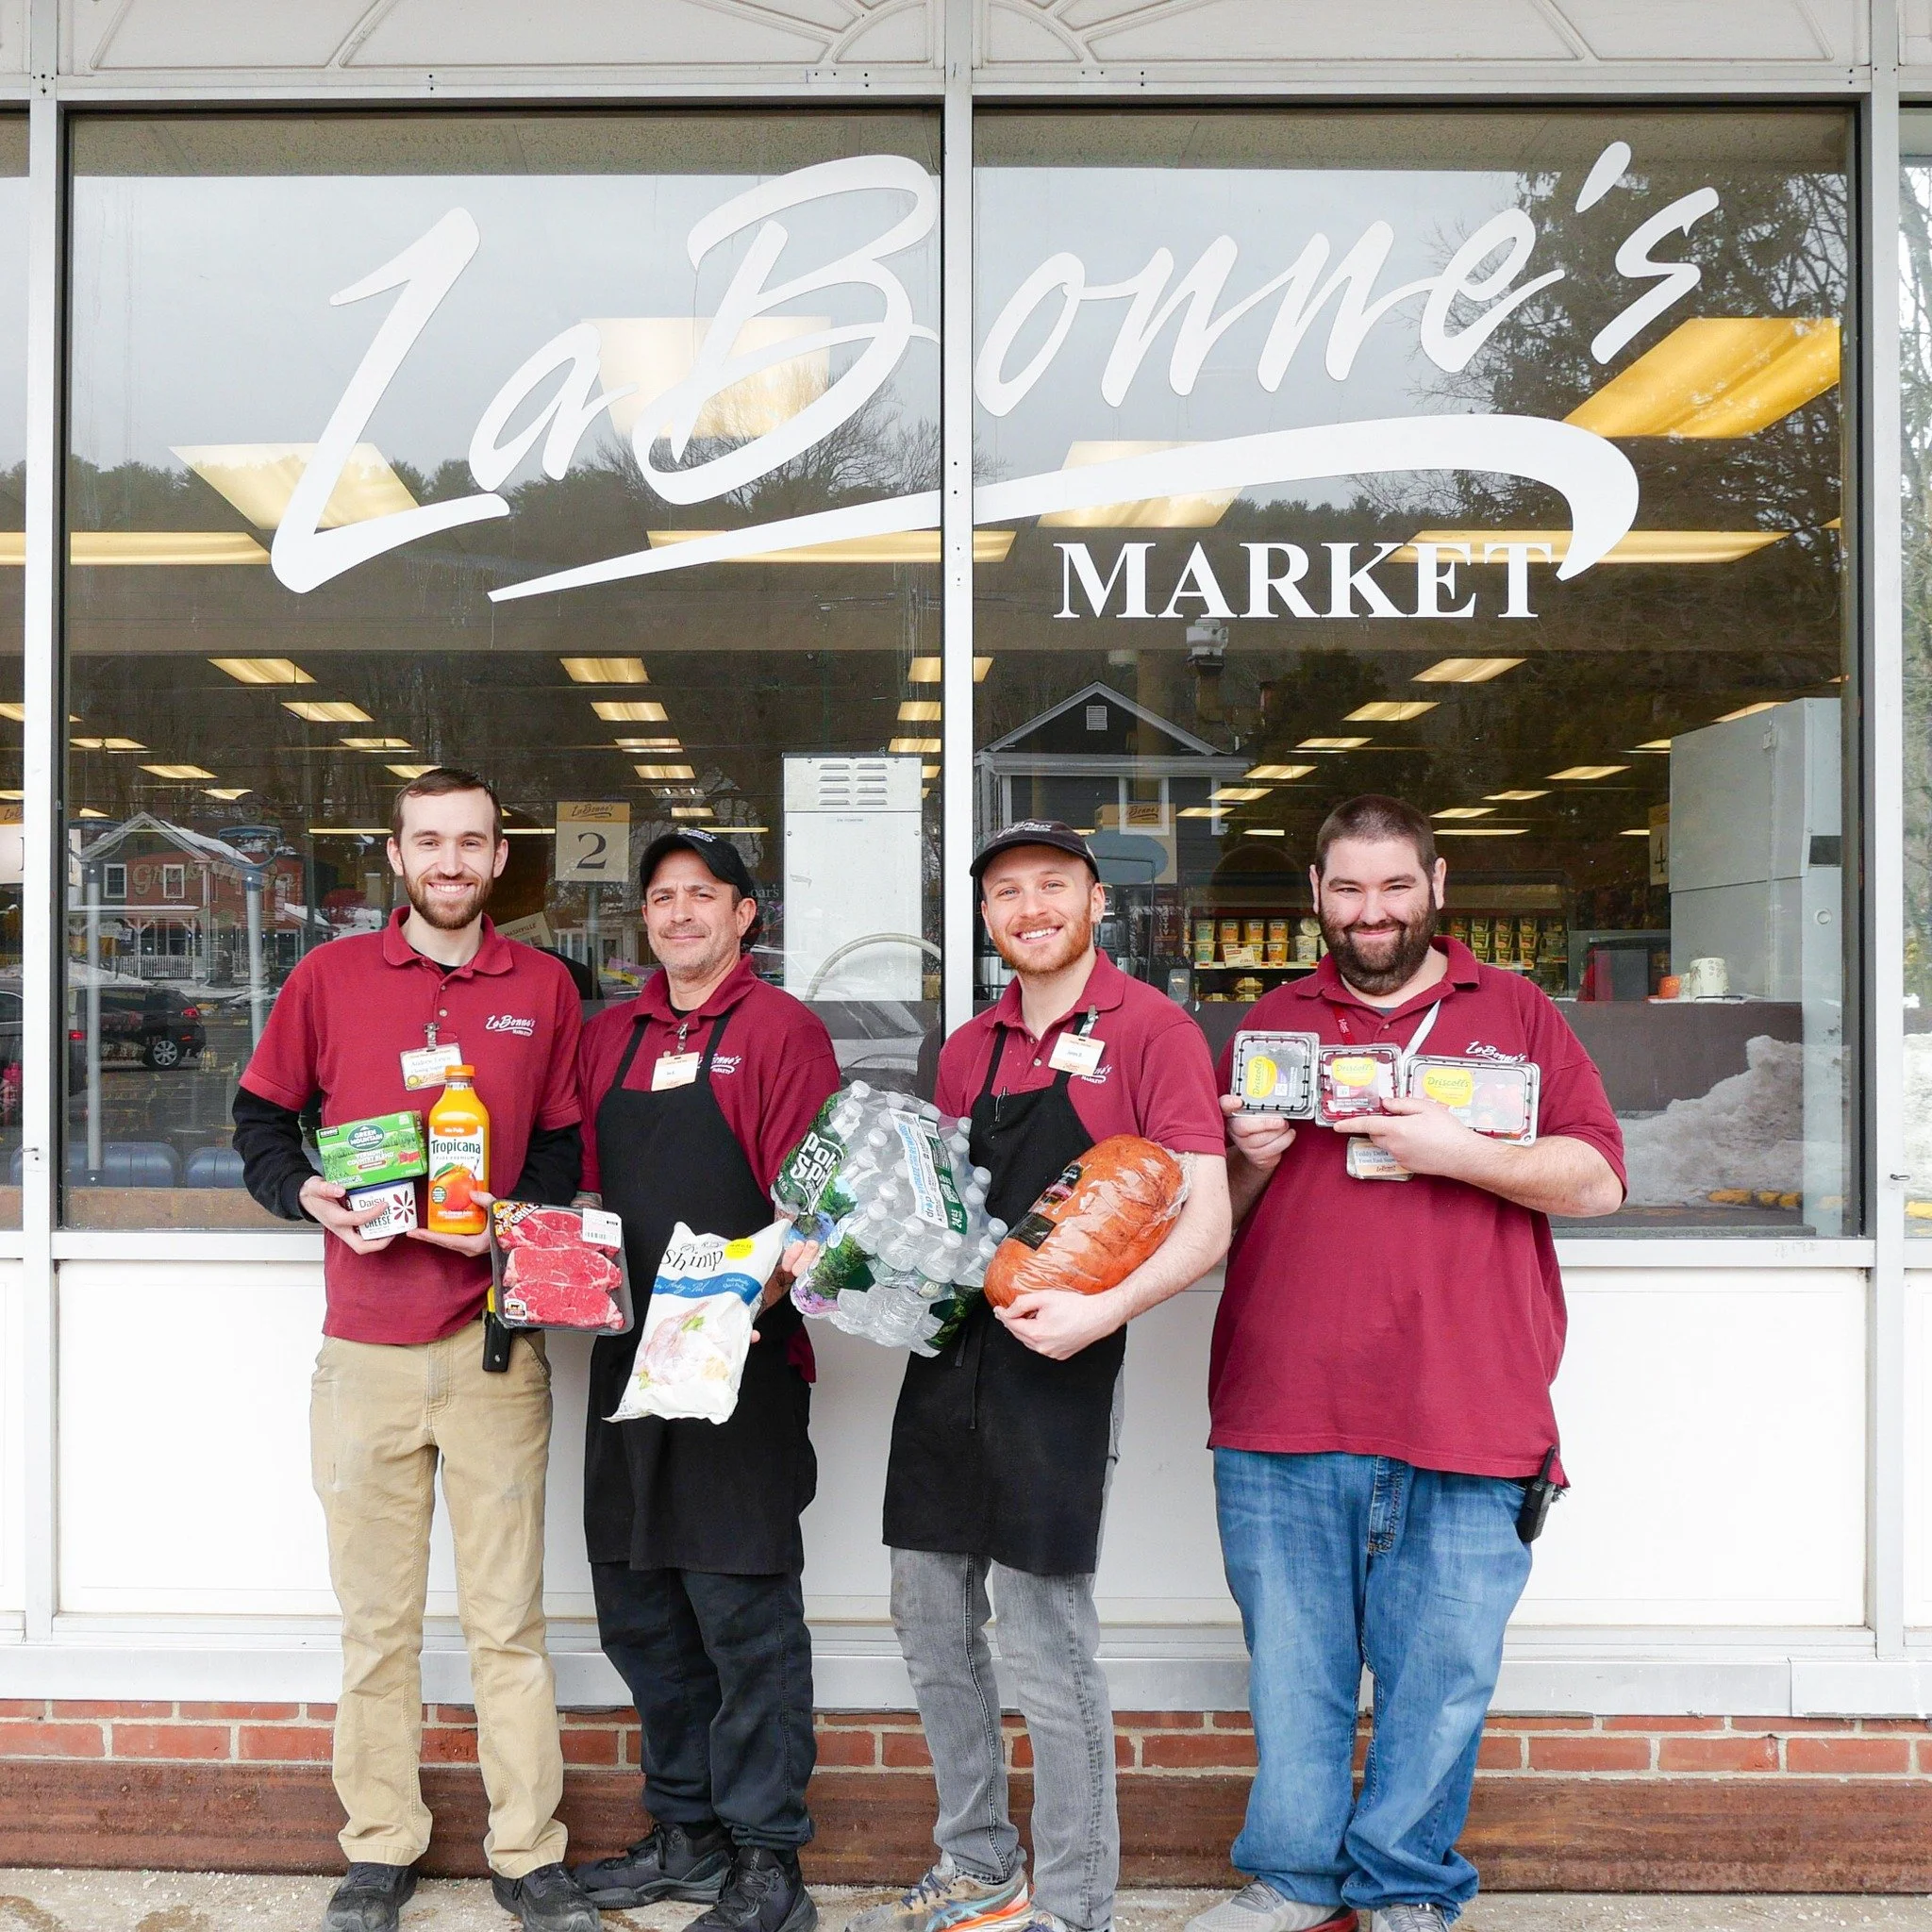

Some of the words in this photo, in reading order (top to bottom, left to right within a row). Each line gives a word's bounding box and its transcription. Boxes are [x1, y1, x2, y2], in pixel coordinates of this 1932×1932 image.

[271, 141, 1719, 594] LaBonne's
[1052, 541, 1552, 621] MARKET
[576, 832, 607, 869] 2
[750, 884, 779, 898] oar's
[485, 1014, 535, 1030] LaBonne's
[1426, 1076, 1471, 1088] Driscoll's
[350, 1134, 384, 1145] MOUNTAIN
[354, 1129, 377, 1139] GREEN
[431, 1139, 481, 1156] Tropicana
[364, 1215, 391, 1229] CHEESE
[509, 1204, 540, 1224] GRILL
